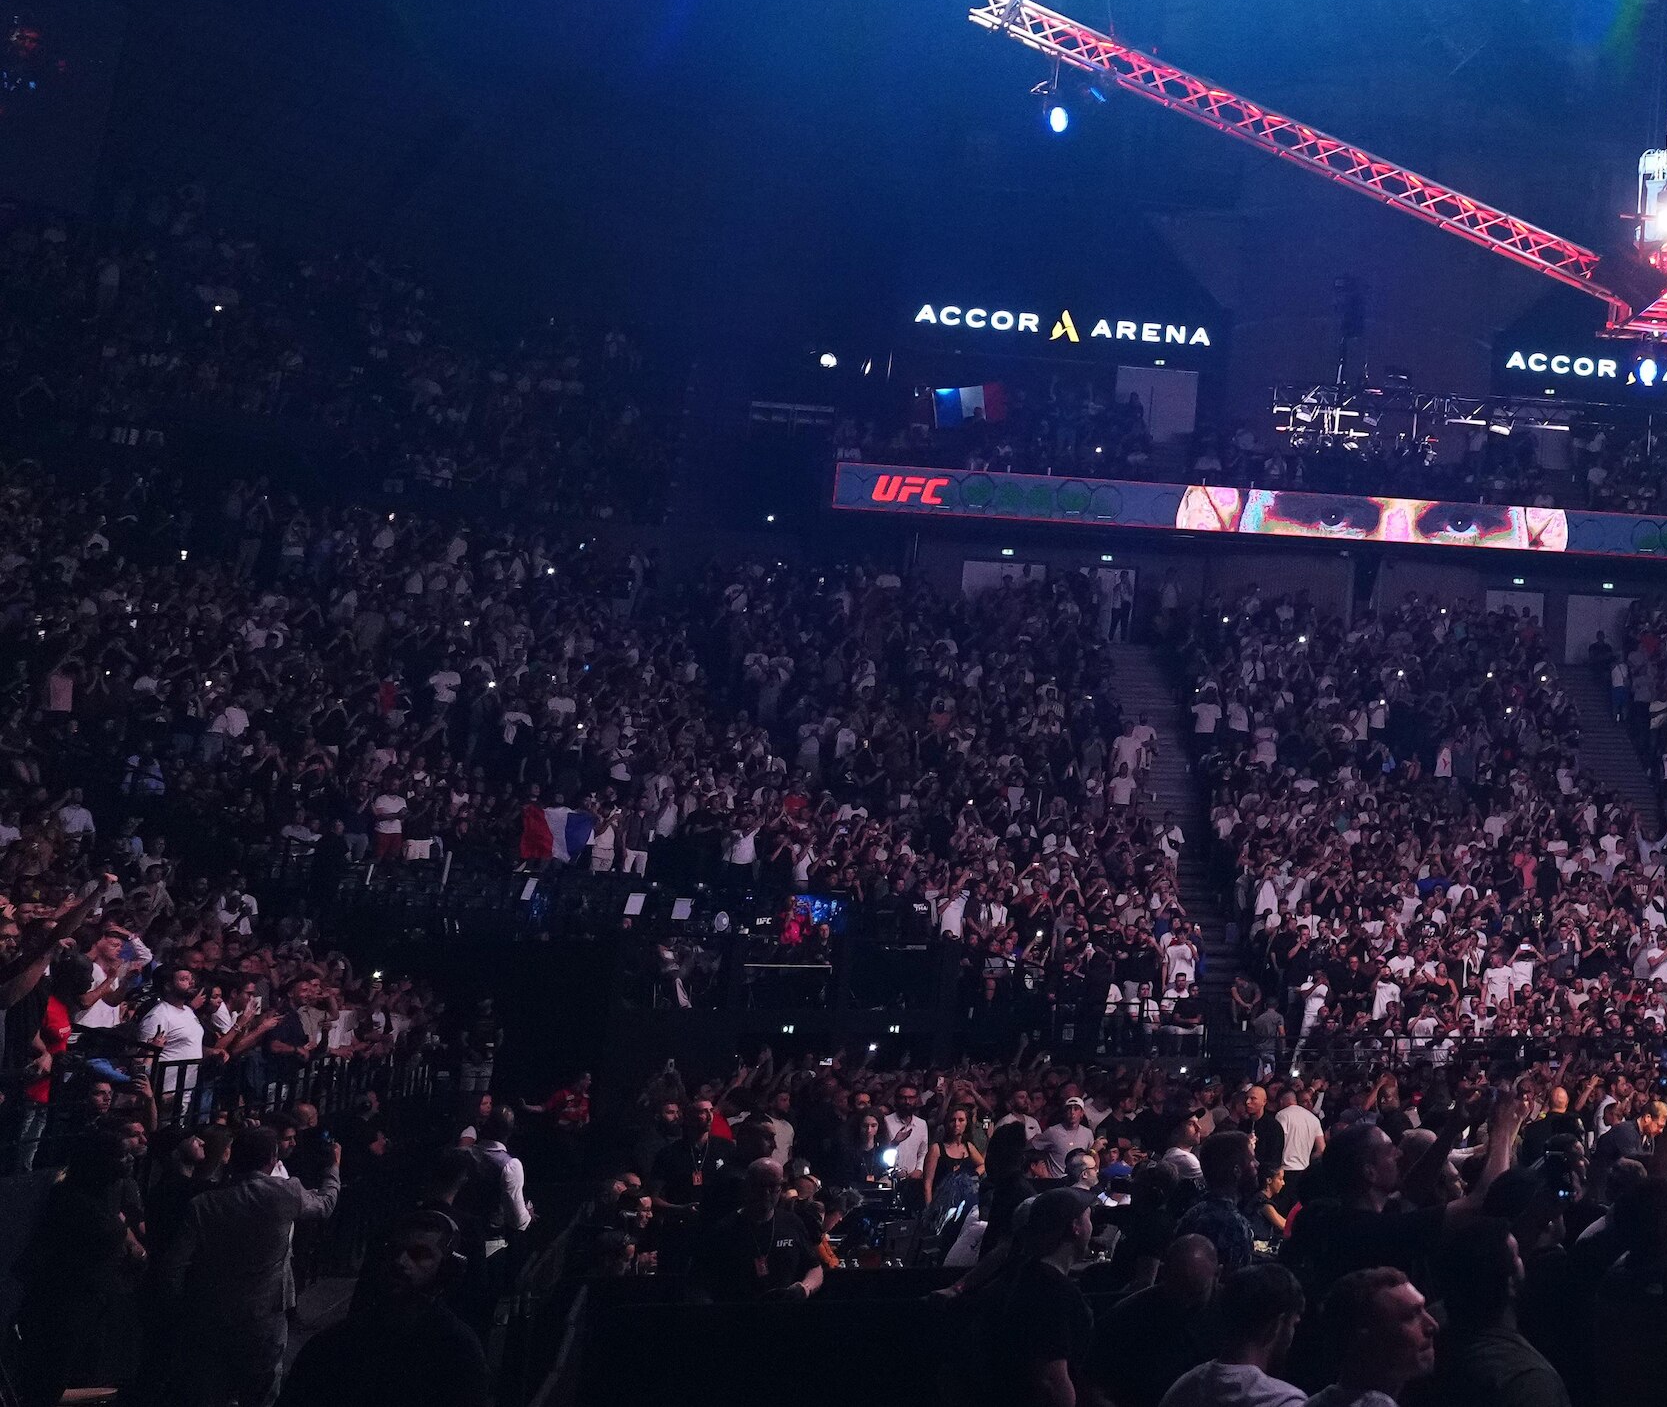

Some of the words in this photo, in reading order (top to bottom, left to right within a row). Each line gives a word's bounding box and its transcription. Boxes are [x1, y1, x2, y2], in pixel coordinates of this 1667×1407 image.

[914, 304, 1039, 333] ACCOR
[1091, 319, 1212, 346] ARENA
[1506, 350, 1617, 378] ACCOR
[871, 475, 948, 505] UFC
[755, 917, 772, 926] UFC
[776, 1239, 793, 1247] UFC
